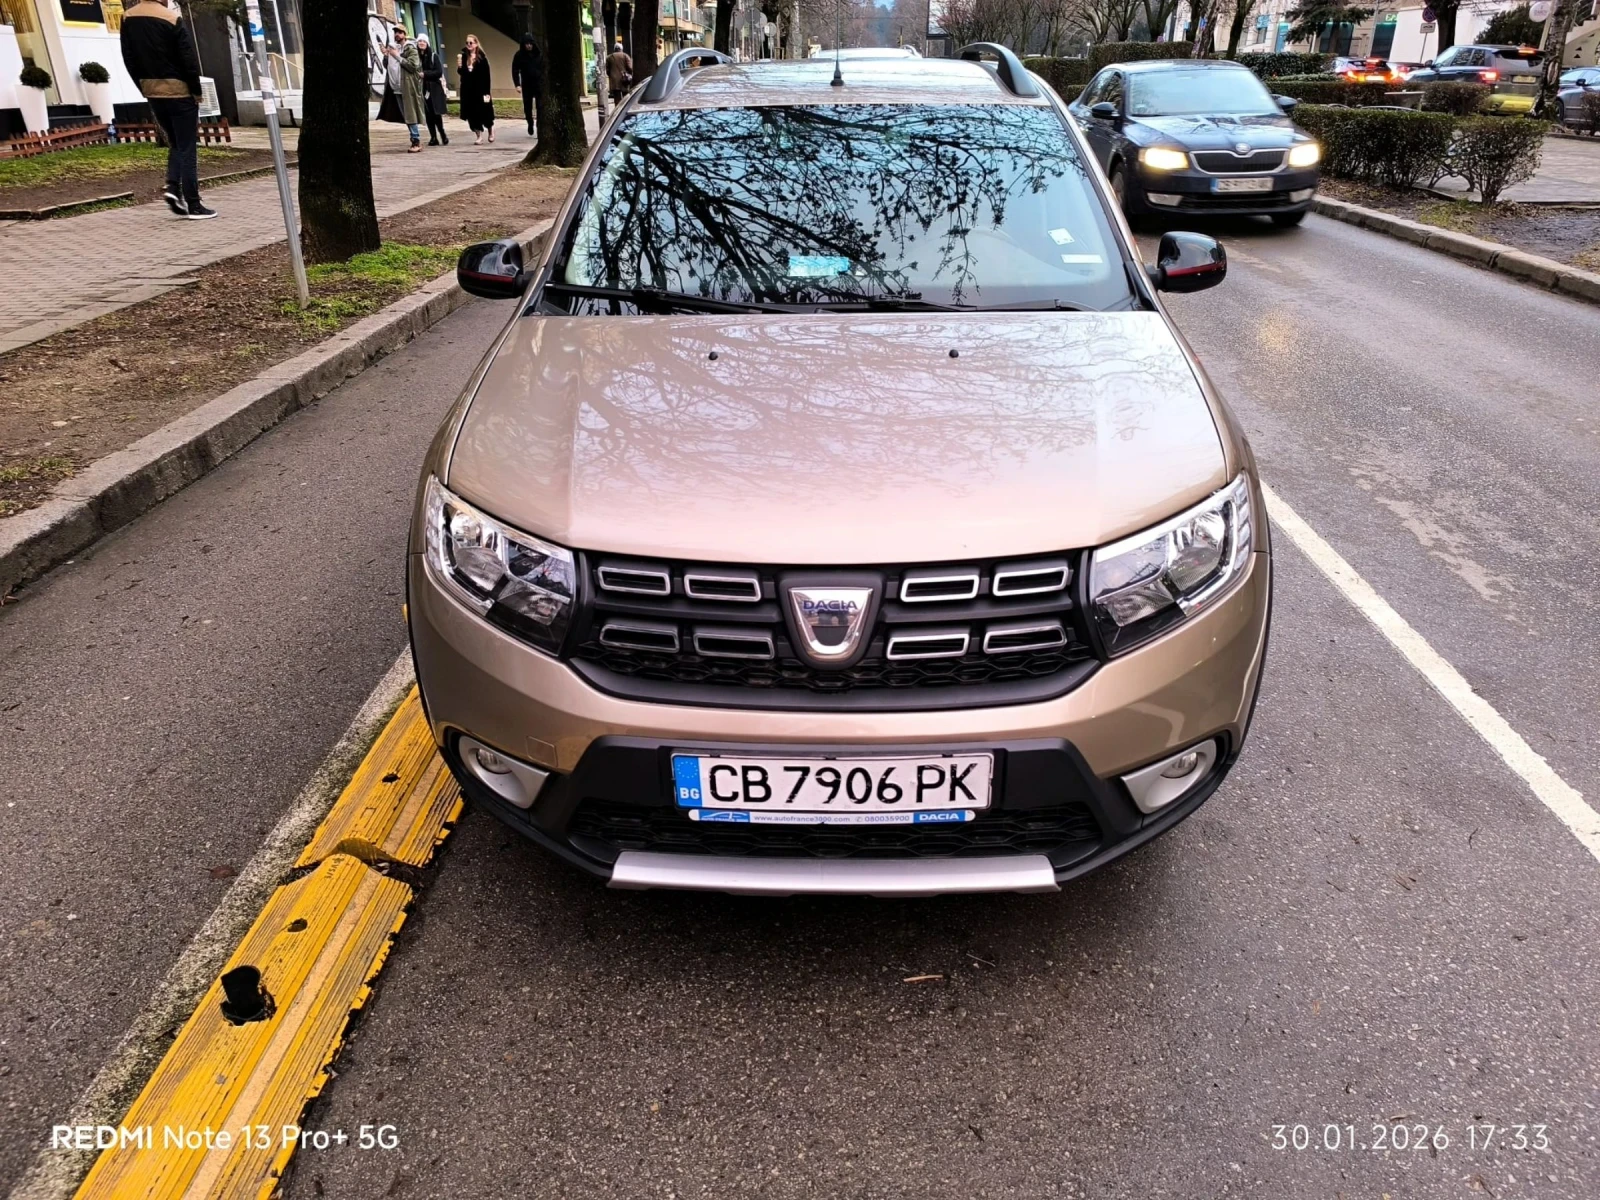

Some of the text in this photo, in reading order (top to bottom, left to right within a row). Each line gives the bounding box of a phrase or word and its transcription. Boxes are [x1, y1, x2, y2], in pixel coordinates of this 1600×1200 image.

[803, 600, 858, 610] DACIA
[709, 763, 979, 804] CB 7906 PK
[680, 787, 700, 800] BG
[919, 812, 960, 821] DACIA
